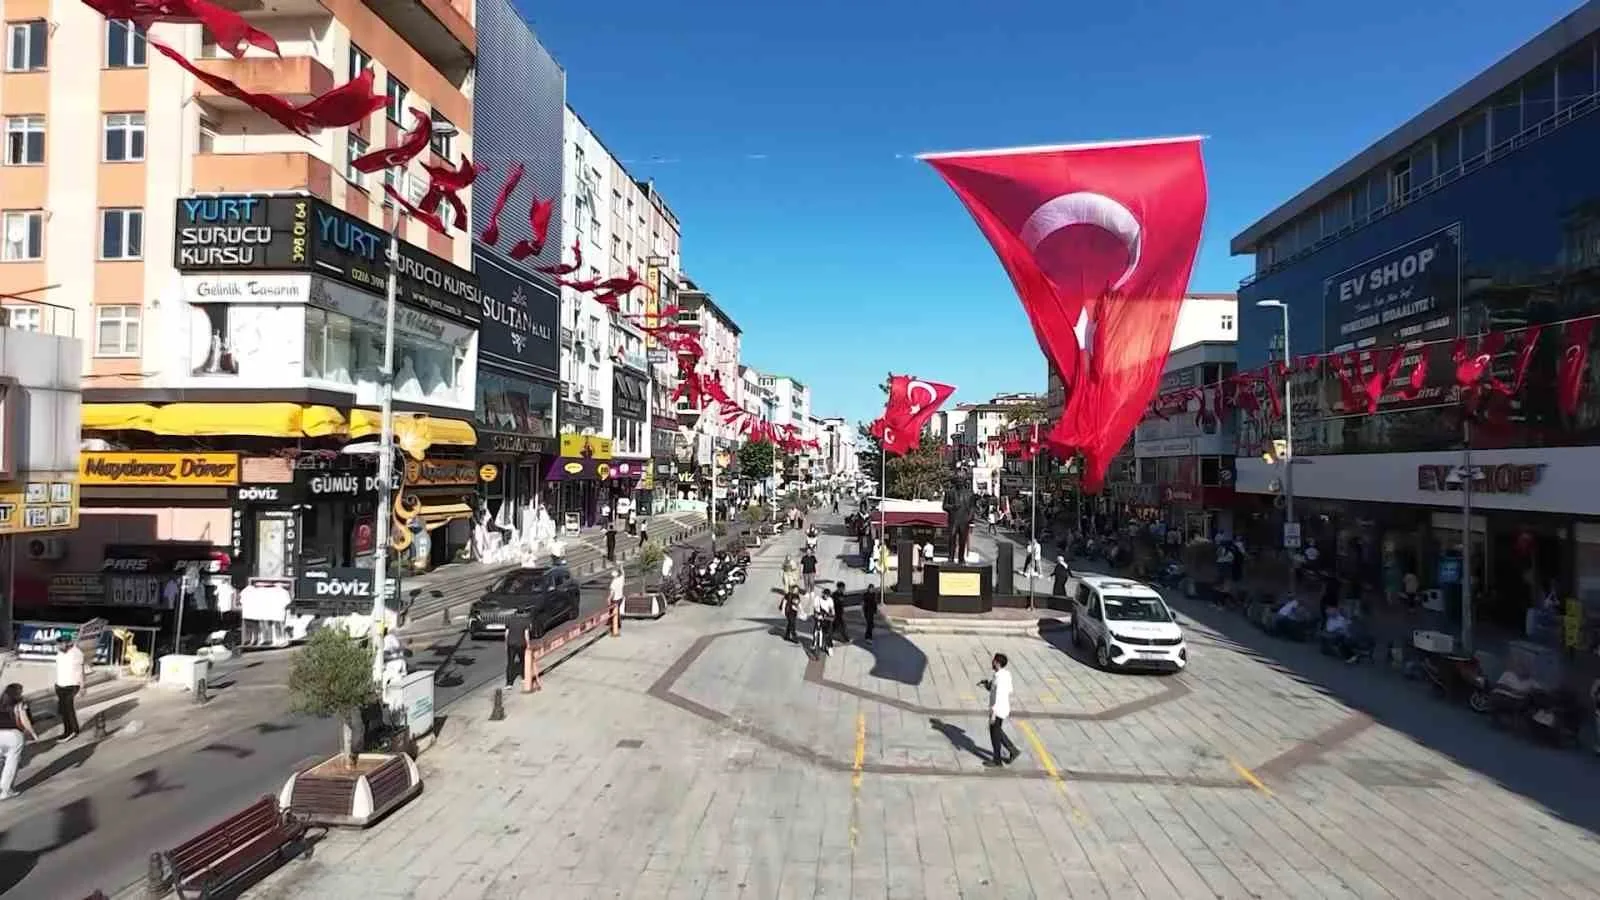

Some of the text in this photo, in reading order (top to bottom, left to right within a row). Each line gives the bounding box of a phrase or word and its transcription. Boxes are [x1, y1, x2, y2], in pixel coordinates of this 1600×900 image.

[183, 199, 258, 221] YURT
[181, 226, 272, 244] SÜRÜCÜ
[317, 208, 381, 260] YURT
[181, 247, 254, 265] KURSU
[1340, 273, 1366, 301] EV
[1369, 247, 1434, 290] SHOP
[197, 282, 242, 296] Gelinlik
[443, 274, 482, 304] KURSU
[483, 296, 532, 333] SULTAN
[180, 458, 236, 479] Döner
[1418, 464, 1446, 491] EV
[239, 487, 278, 500] DÖVİZ
[311, 472, 359, 495] GÜMÜŞ
[104, 558, 148, 570] PARS
[316, 579, 370, 596] DÖVİZ
